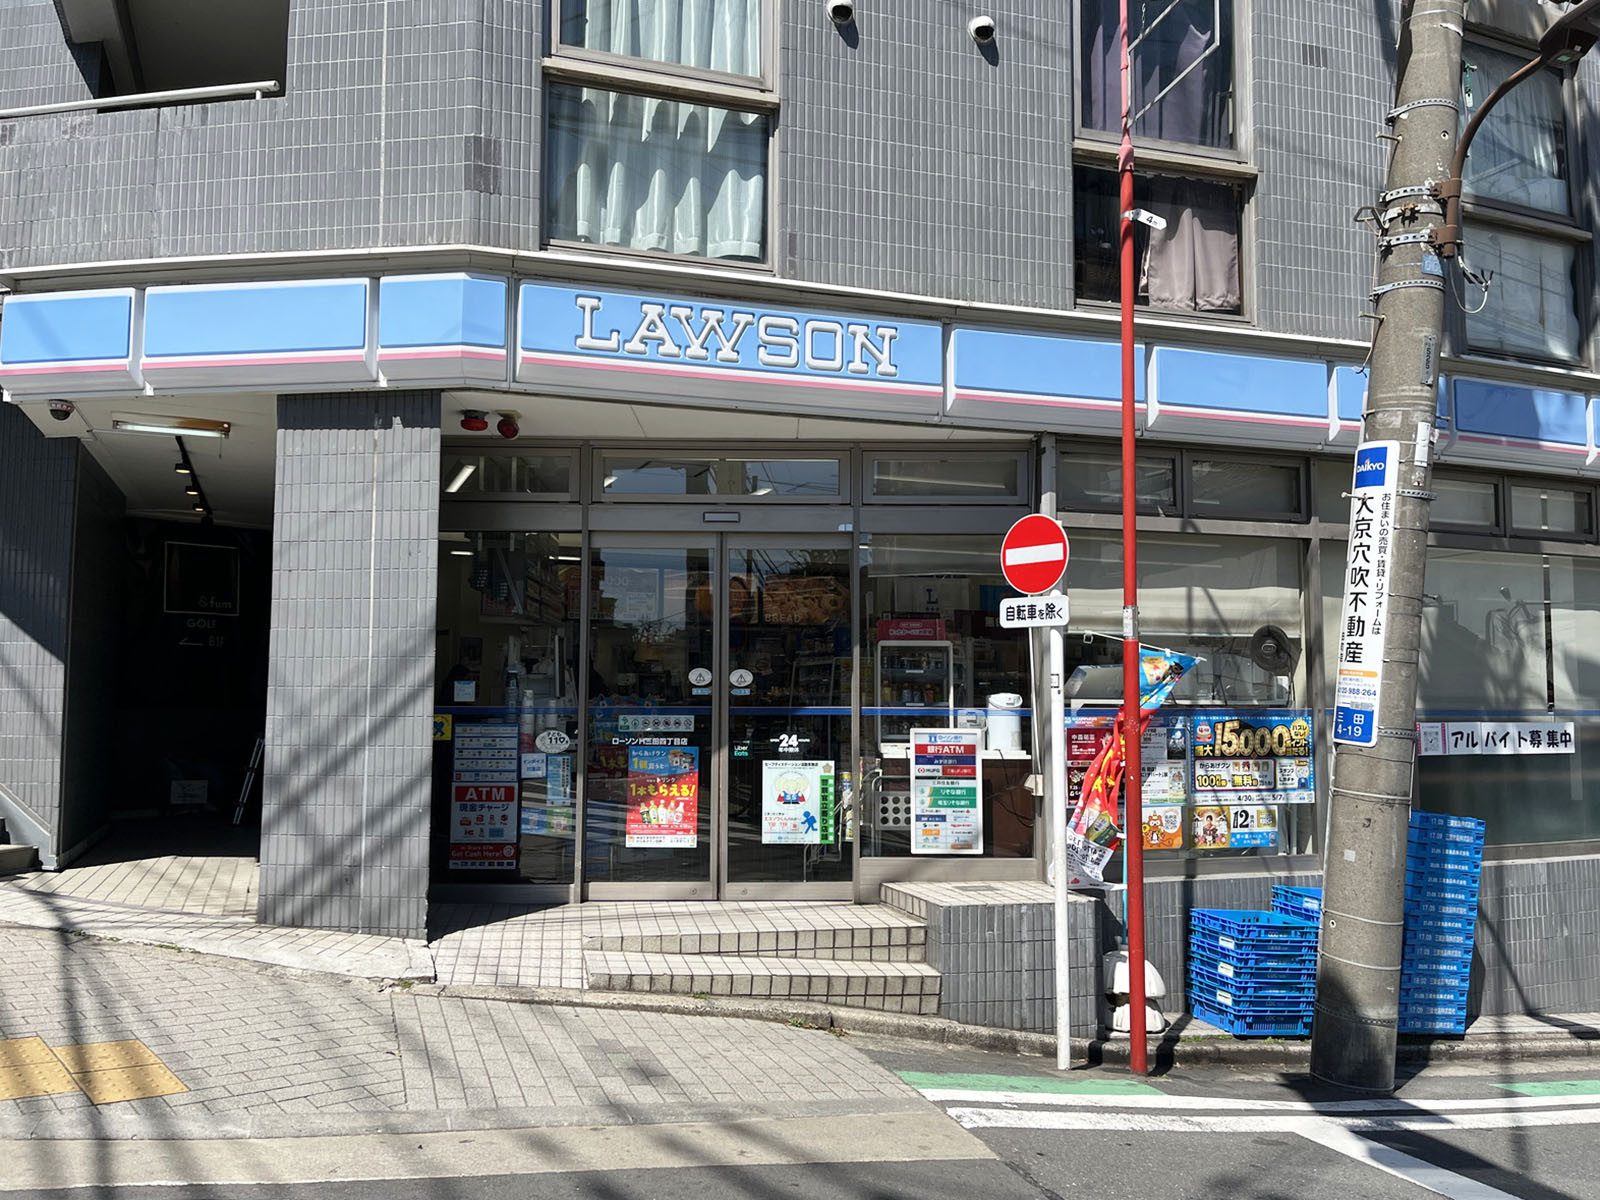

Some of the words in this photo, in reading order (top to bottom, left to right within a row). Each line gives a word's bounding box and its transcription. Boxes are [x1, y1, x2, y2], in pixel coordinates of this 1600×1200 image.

[576, 296, 898, 377] LAWSON
[1345, 492, 1374, 664] 大京穴吹不動産
[1006, 602, 1063, 621] 自転車を除く
[1337, 712, 1365, 725] 三田
[1336, 724, 1363, 737] 4-19
[779, 734, 799, 747] 24
[1451, 730, 1572, 749] アルバイト募集中
[927, 745, 965, 754] 銀行ATM
[465, 787, 505, 801] ATM
[459, 803, 510, 812] 現金チャージ
[1232, 810, 1249, 829] 12
